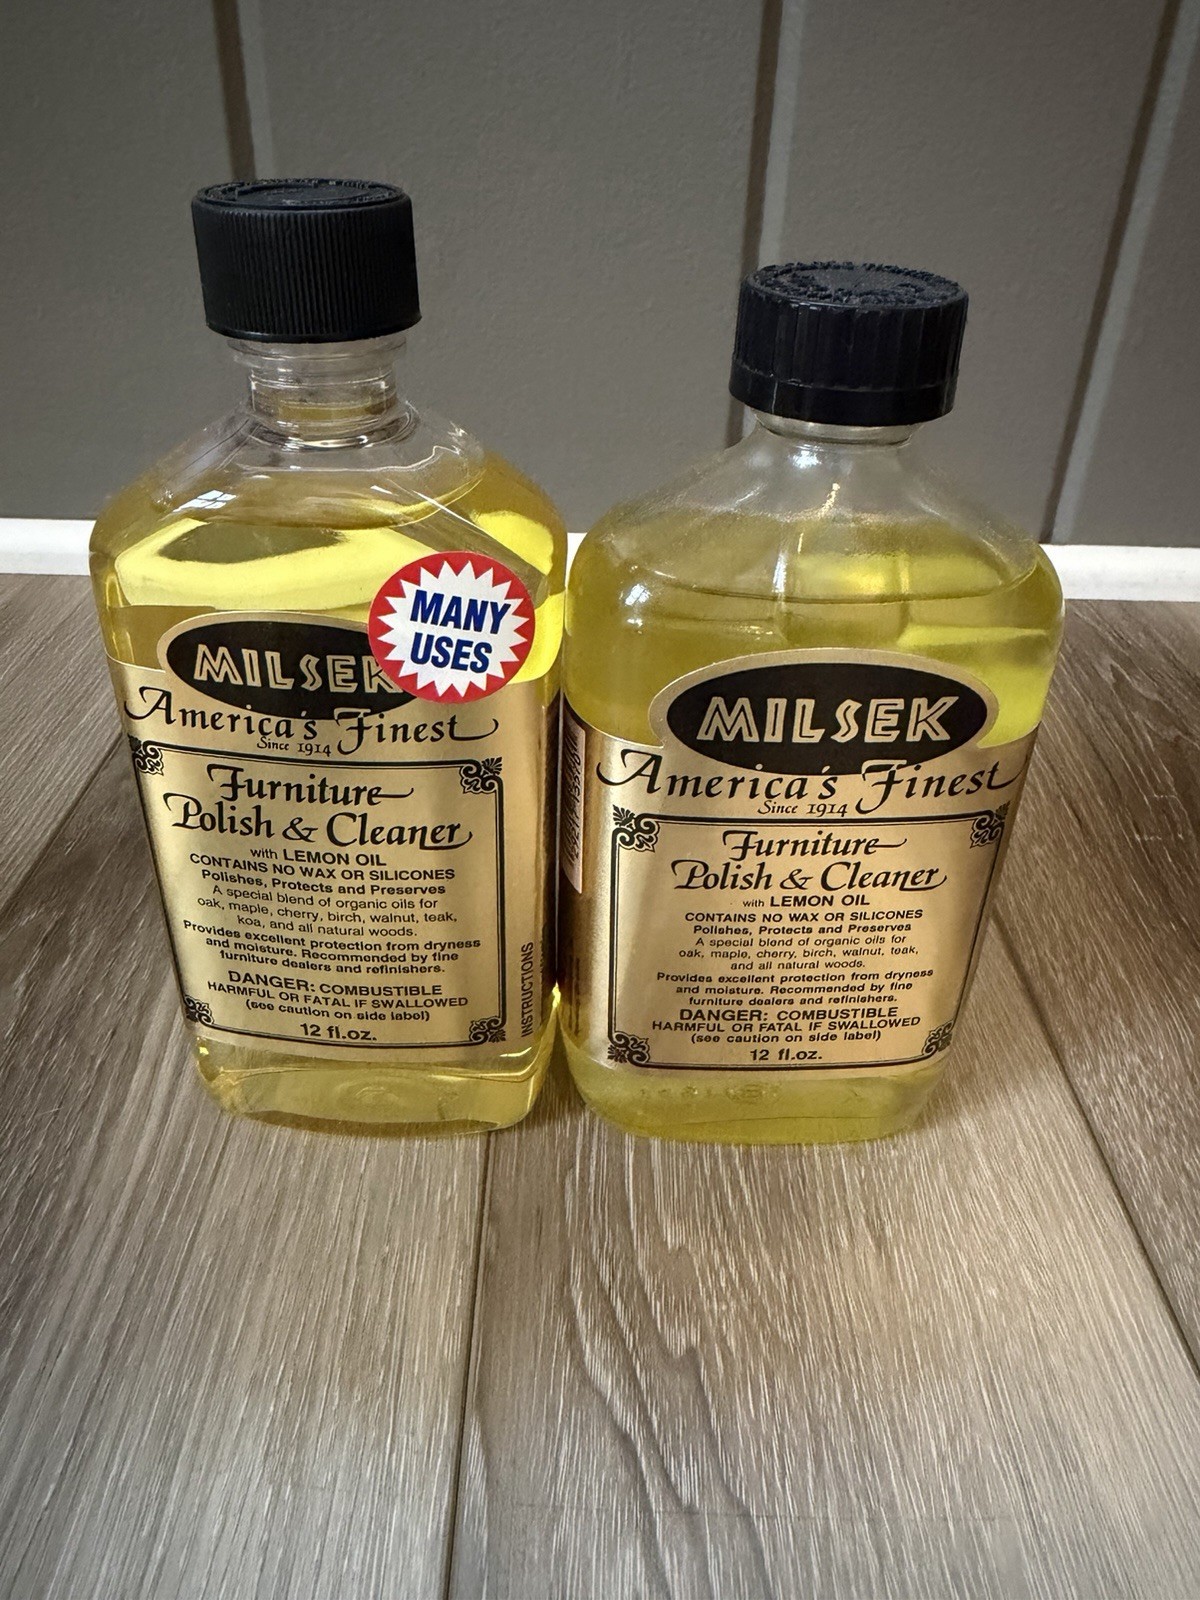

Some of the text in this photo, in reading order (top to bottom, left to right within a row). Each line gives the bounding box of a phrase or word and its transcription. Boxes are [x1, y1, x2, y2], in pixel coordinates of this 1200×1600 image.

[410, 589, 512, 634] MANY
[410, 632, 493, 673] USES
[124, 686, 499, 755] America's Finest
[696, 696, 959, 743] MILSEK
[257, 735, 331, 757] Since 1914
[206, 763, 414, 806] Furniture
[596, 748, 1027, 814] America's Finest
[757, 800, 848, 817] Since 1914
[163, 792, 473, 850] Polish & Cleaner
[250, 848, 387, 866] with LEMON OIL
[722, 830, 907, 861] Furniture
[190, 853, 455, 880] CONTAINS NO WAX OR SILICONES
[670, 859, 947, 891] Polish & Cleaner
[201, 869, 446, 895] Polishes, Protects and Preserves
[213, 885, 438, 911] A special blend of organic oils for
[743, 894, 870, 907] with LEMON OIL
[197, 897, 457, 924] oak, maple, cherry, birch, walnut, teak,
[685, 909, 923, 923] CONTAINS NO WAX OR SILICONES
[183, 919, 481, 952] Provides excellent protection from dryness
[237, 915, 417, 936] koa, and all natural woods.
[693, 923, 912, 936] Polishes, Protects and Preserves
[206, 938, 459, 963] and moisture. Recommended by fine
[678, 945, 919, 960] oak, maple, cherry, birch, walnut, teak,
[695, 934, 907, 948] A special blend of organic oils for
[220, 950, 445, 974] furniture dealers and refinishers.
[730, 959, 865, 970] and all natural woods.
[228, 970, 443, 997] DANGER: COMBUSTIBLE
[657, 969, 934, 984] Provides excellent protection from dryness
[207, 981, 468, 1009] HARMFUL OR FATAL IF SWALLOWED
[521, 941, 534, 1037] INSTRUCTIONS
[676, 982, 913, 995] and moisture. Recommended by fine
[689, 994, 898, 1006] furniture dealers and refinishers.
[246, 999, 430, 1022] (see caution on side label)
[680, 1007, 898, 1022] DANGER: COMBUSTIBLE
[300, 1022, 321, 1036] 12
[652, 1017, 921, 1033] HARMFUL OR FATAL IF SWALLOWED
[691, 1030, 881, 1044] (see caution on side label)
[750, 1049, 769, 1061] 12
